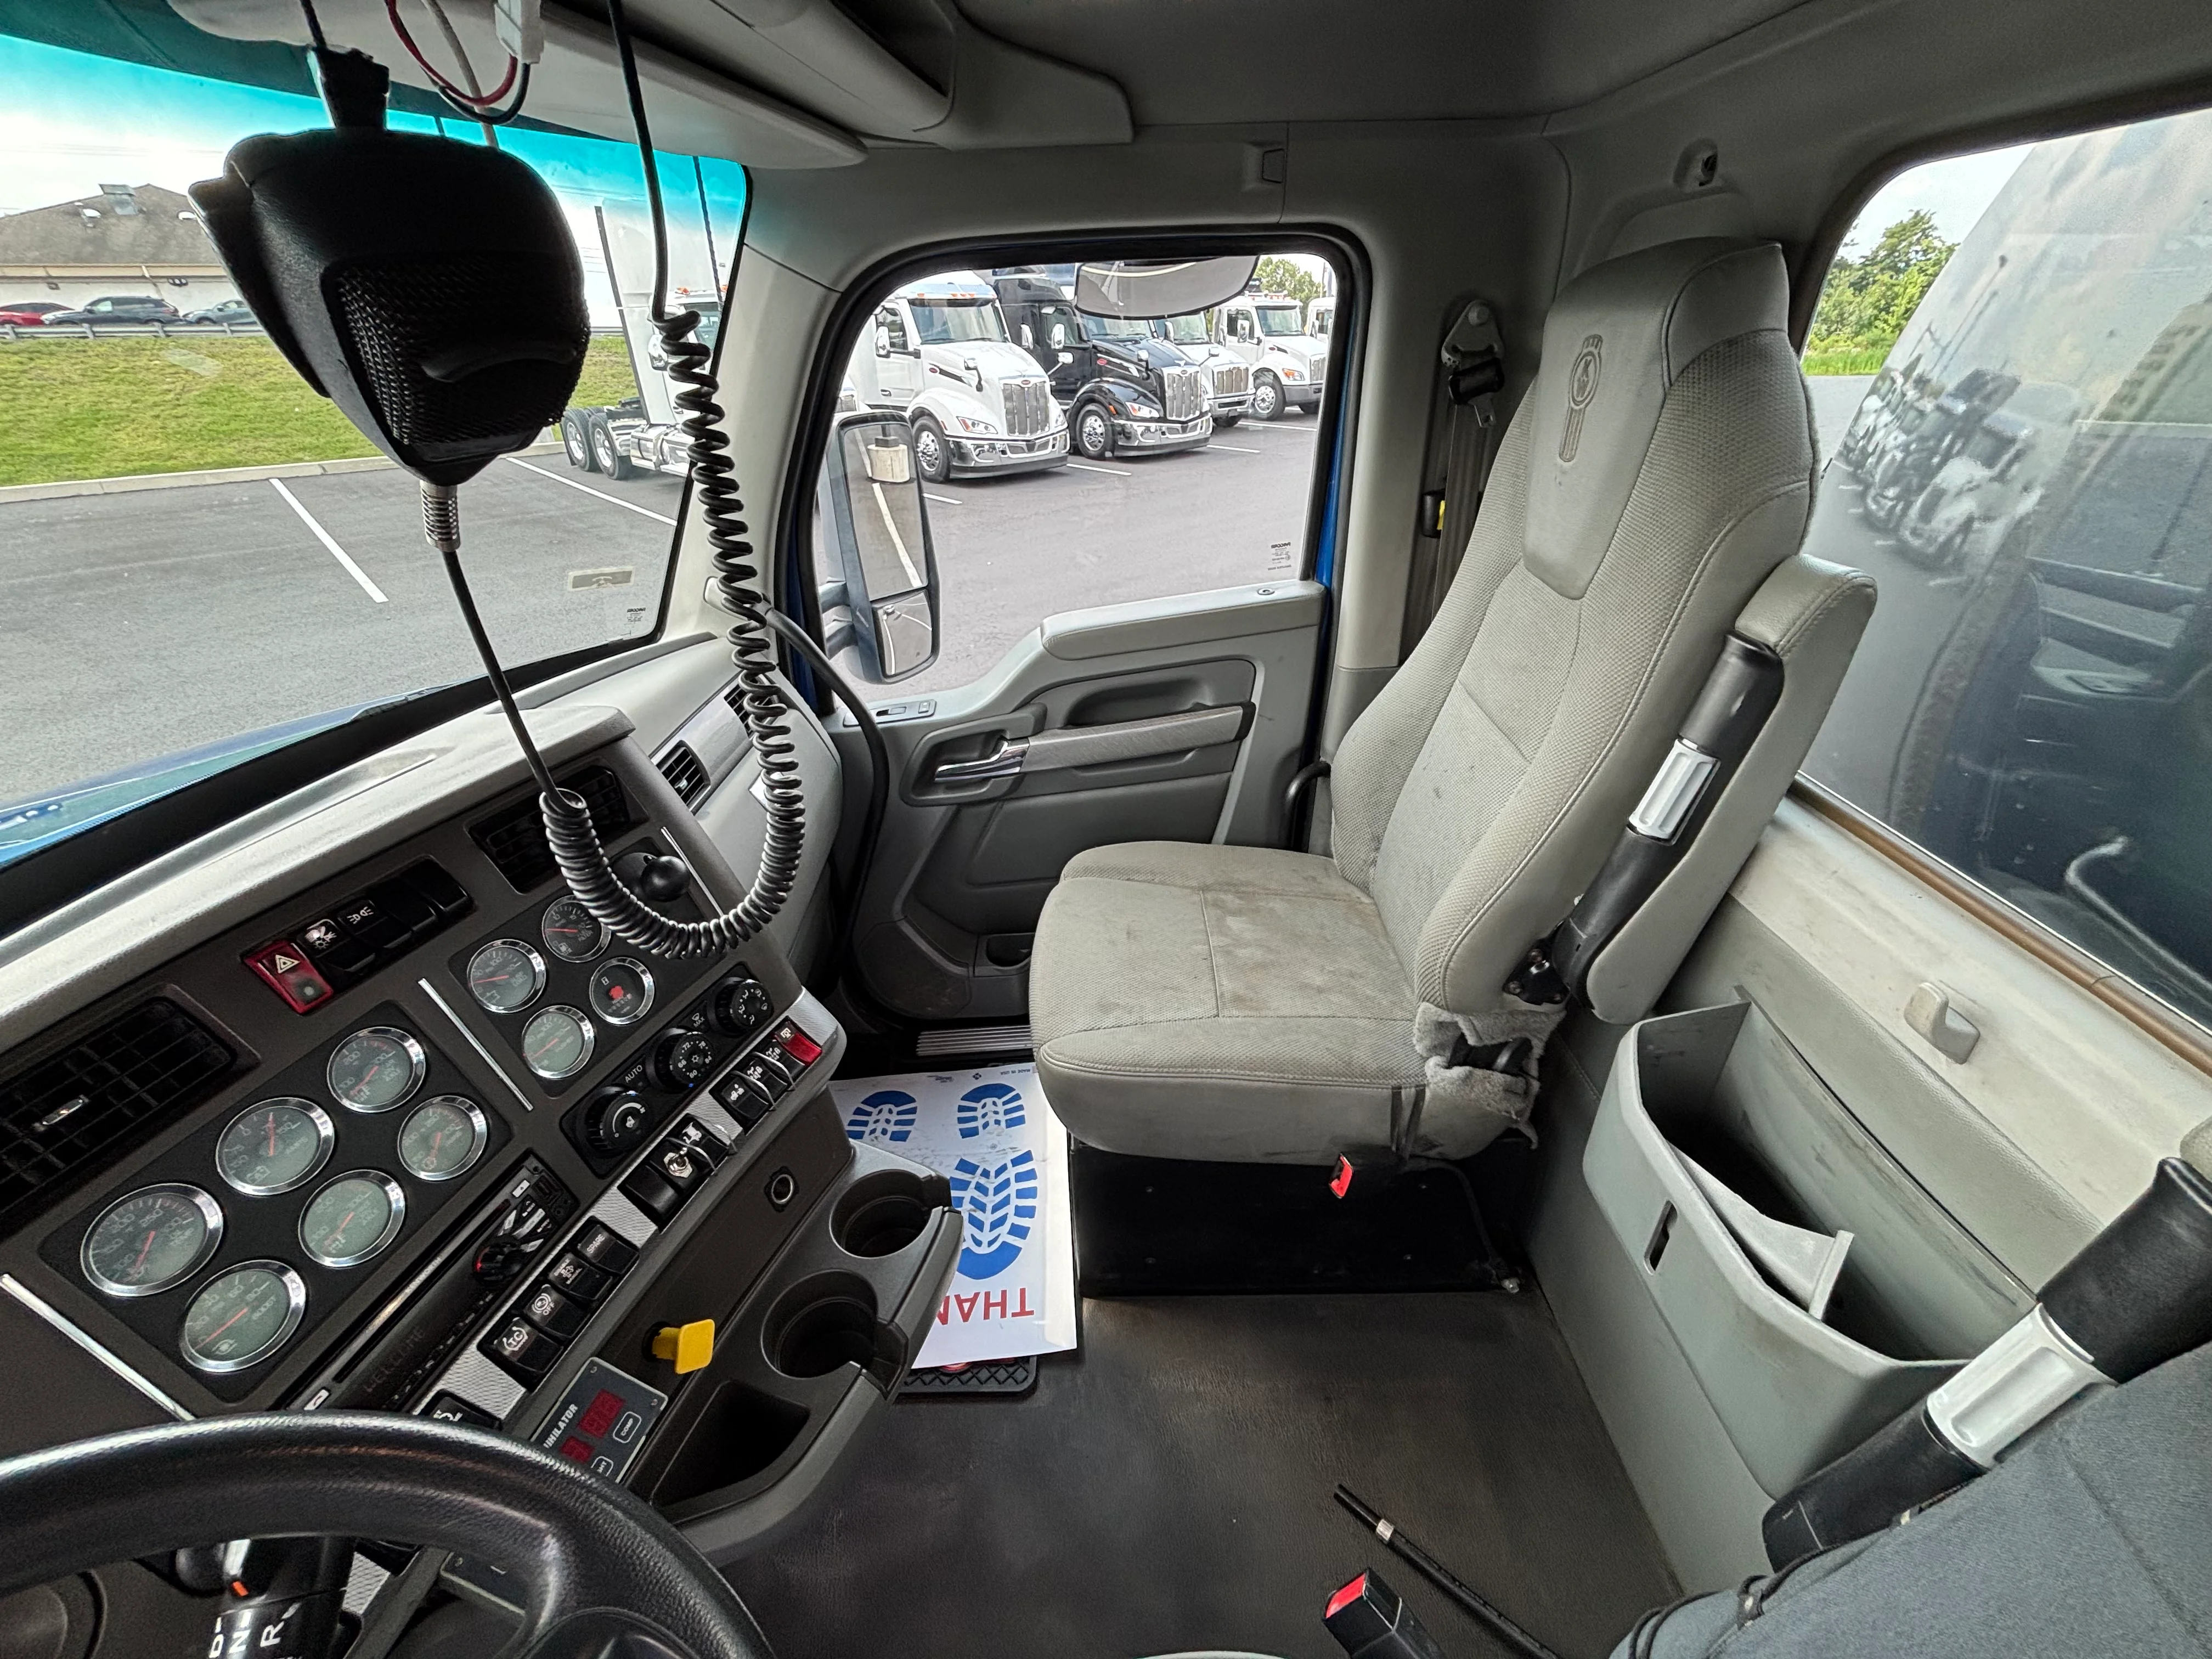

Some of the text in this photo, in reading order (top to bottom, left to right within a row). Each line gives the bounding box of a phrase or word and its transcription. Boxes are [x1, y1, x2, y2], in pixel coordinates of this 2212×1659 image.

[693, 1016, 705, 1028] MAX
[682, 1042, 691, 1051] 72
[698, 1041, 706, 1049] 78
[678, 1059, 686, 1068] 66
[704, 1055, 712, 1064] 84
[624, 1064, 643, 1084] AUTO
[689, 1070, 698, 1079] 60
[139, 1208, 163, 1228] 250
[586, 1234, 606, 1254] SPARE
[228, 1285, 244, 1298] 60
[252, 1295, 276, 1320] BOOST
[543, 1301, 555, 1316] OFF
[507, 1331, 523, 1346] TC
[620, 1418, 633, 1436] COMP
[228, 1629, 251, 1654] N
[260, 1621, 285, 1648] R
